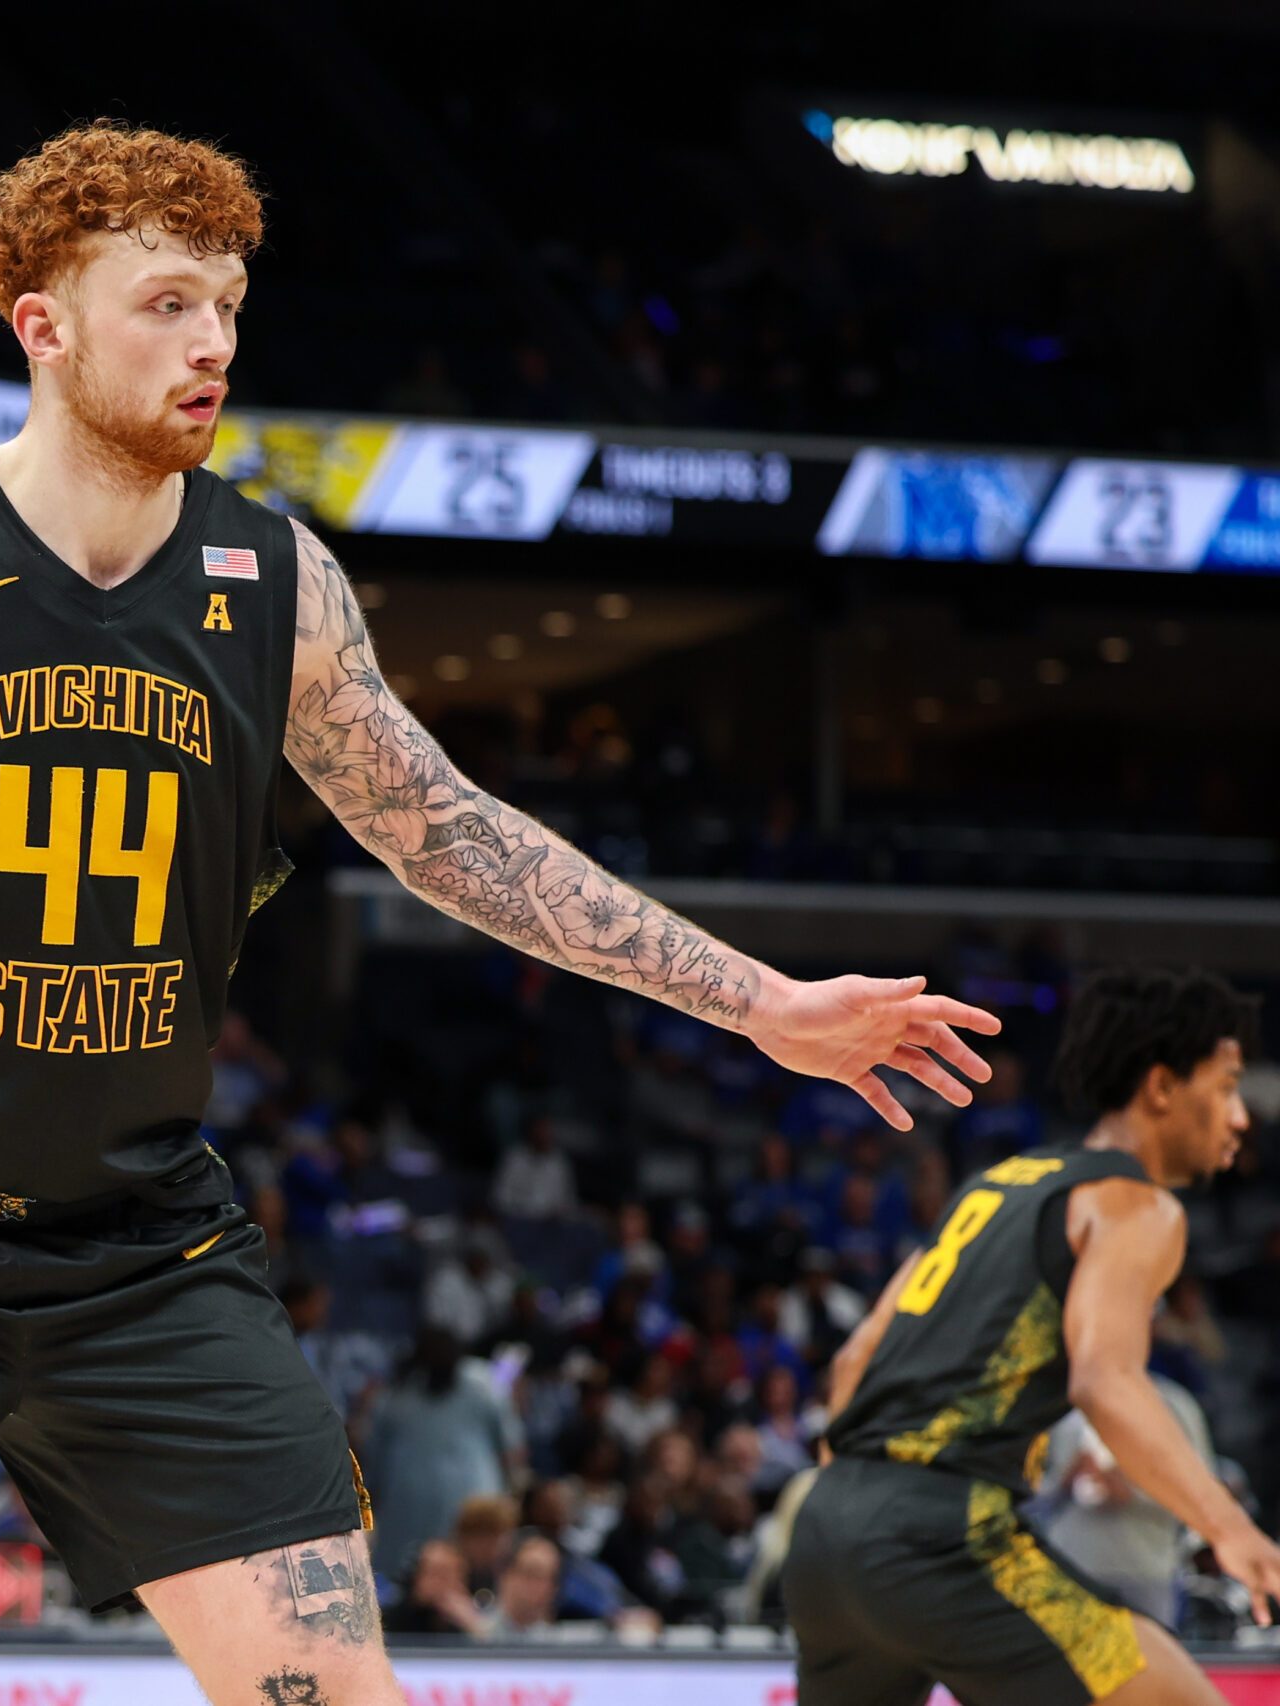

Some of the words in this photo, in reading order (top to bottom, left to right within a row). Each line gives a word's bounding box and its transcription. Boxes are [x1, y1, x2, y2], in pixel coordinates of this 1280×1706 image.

[446, 440, 525, 528] 25
[203, 593, 233, 631] A
[895, 1187, 1005, 1316] 8
